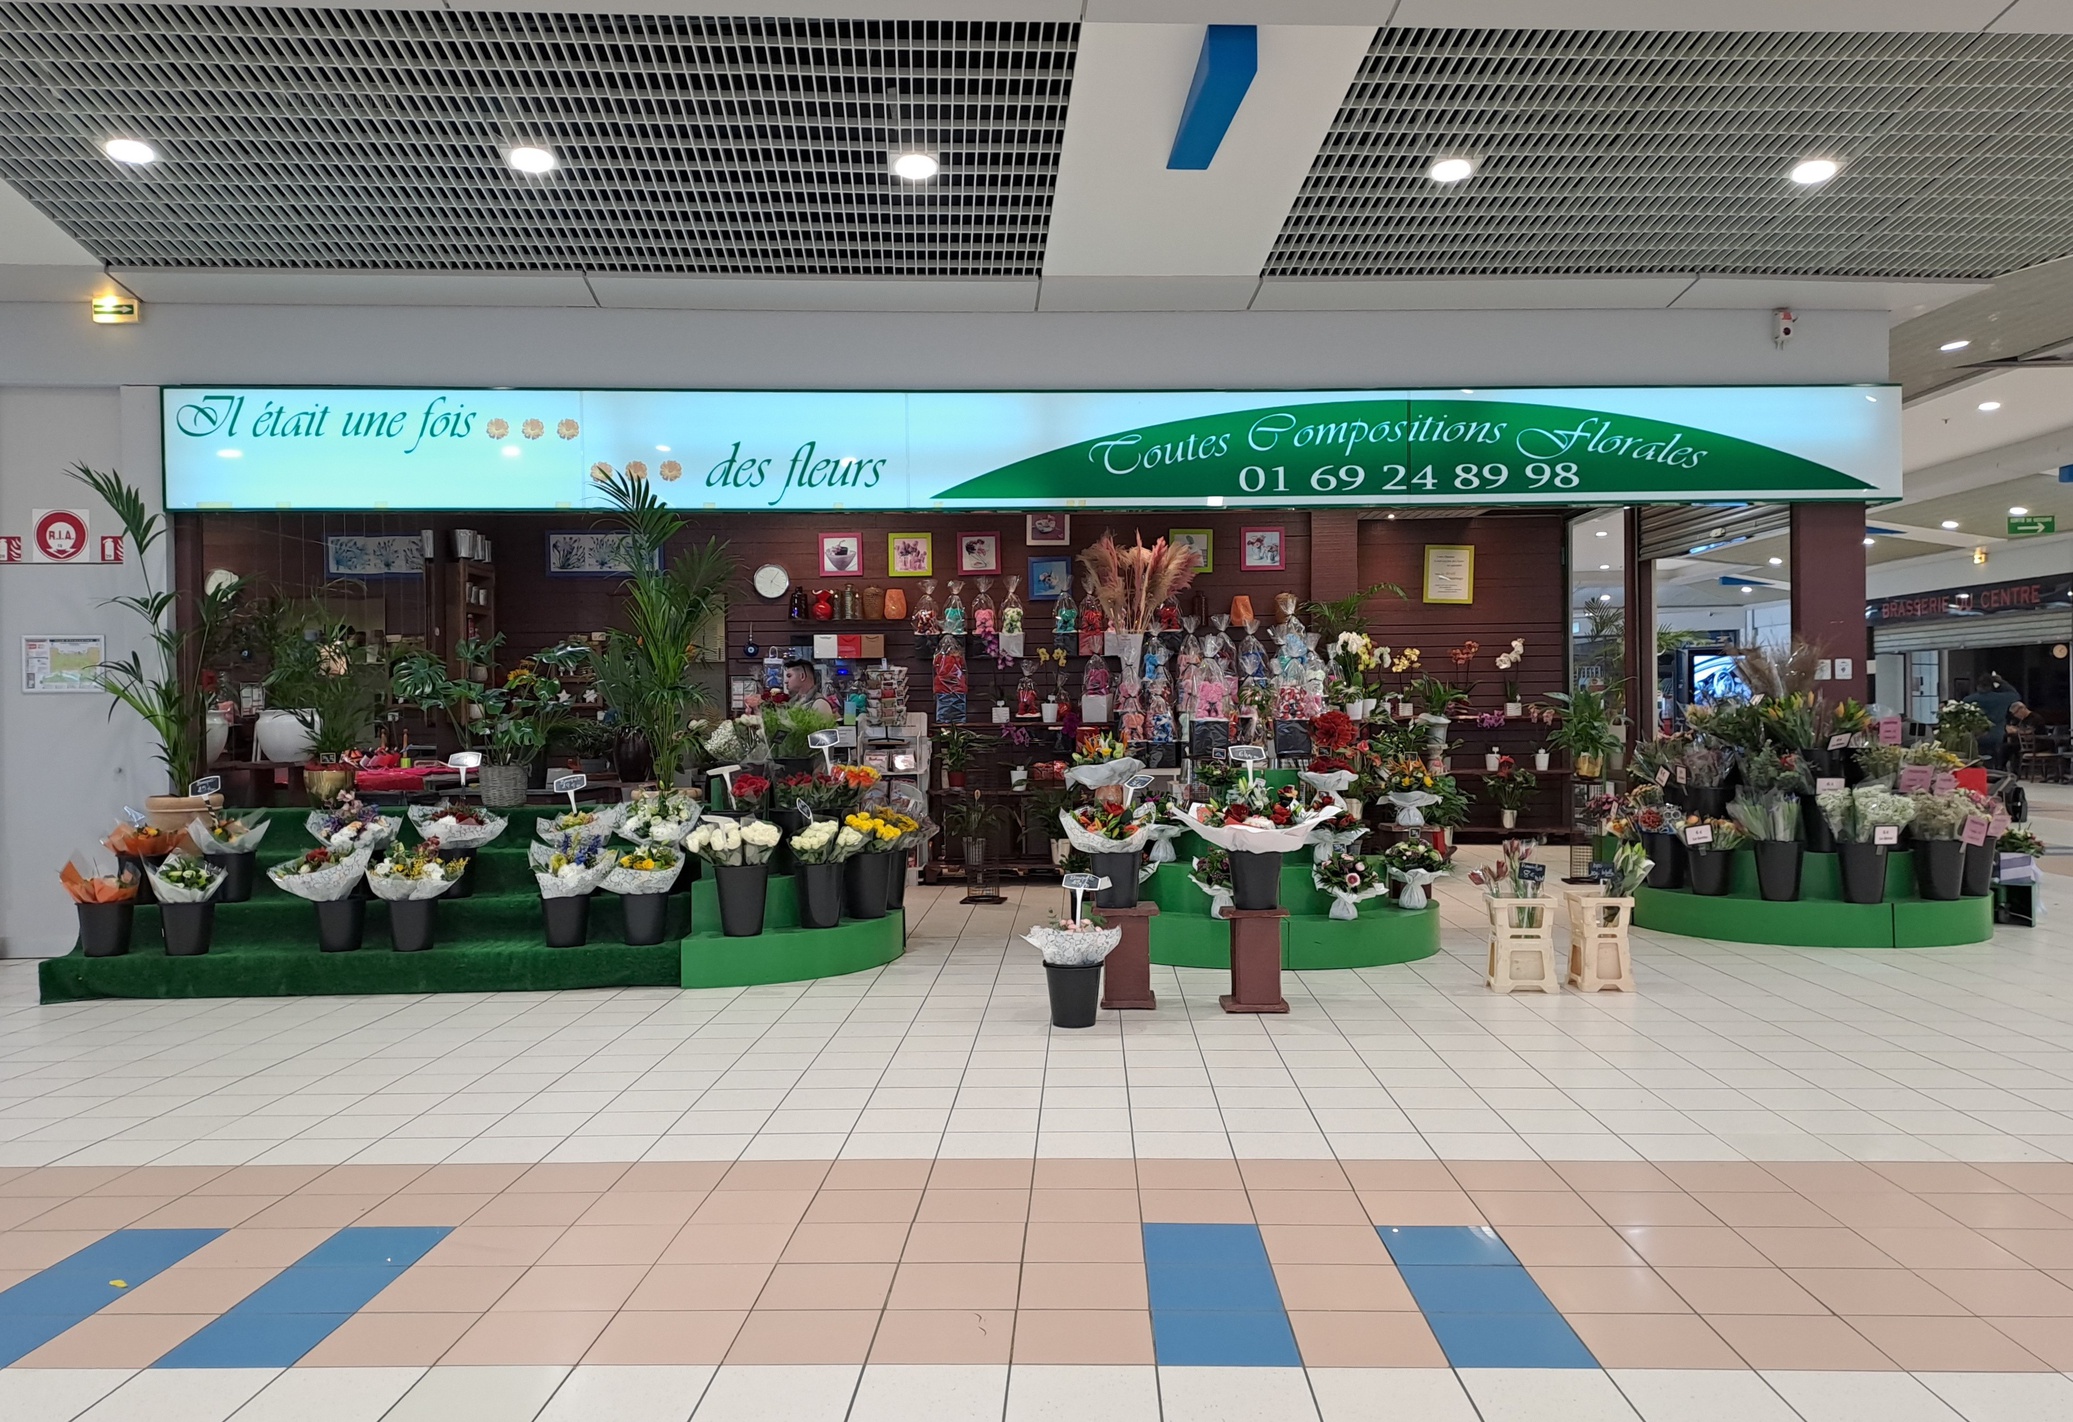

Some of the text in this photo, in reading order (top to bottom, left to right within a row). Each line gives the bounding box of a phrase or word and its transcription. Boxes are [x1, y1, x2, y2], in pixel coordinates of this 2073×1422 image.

[176, 395, 477, 454] Il était une fois
[1088, 413, 1708, 475] Toutes Compositions Florales
[705, 440, 887, 506] des fleurs
[1238, 462, 1580, 492] 01 69 24 89 98
[48, 530, 75, 541] R.I.A.
[1881, 596, 1950, 619] BRASSERIE
[1980, 585, 2041, 608] CENTRE
